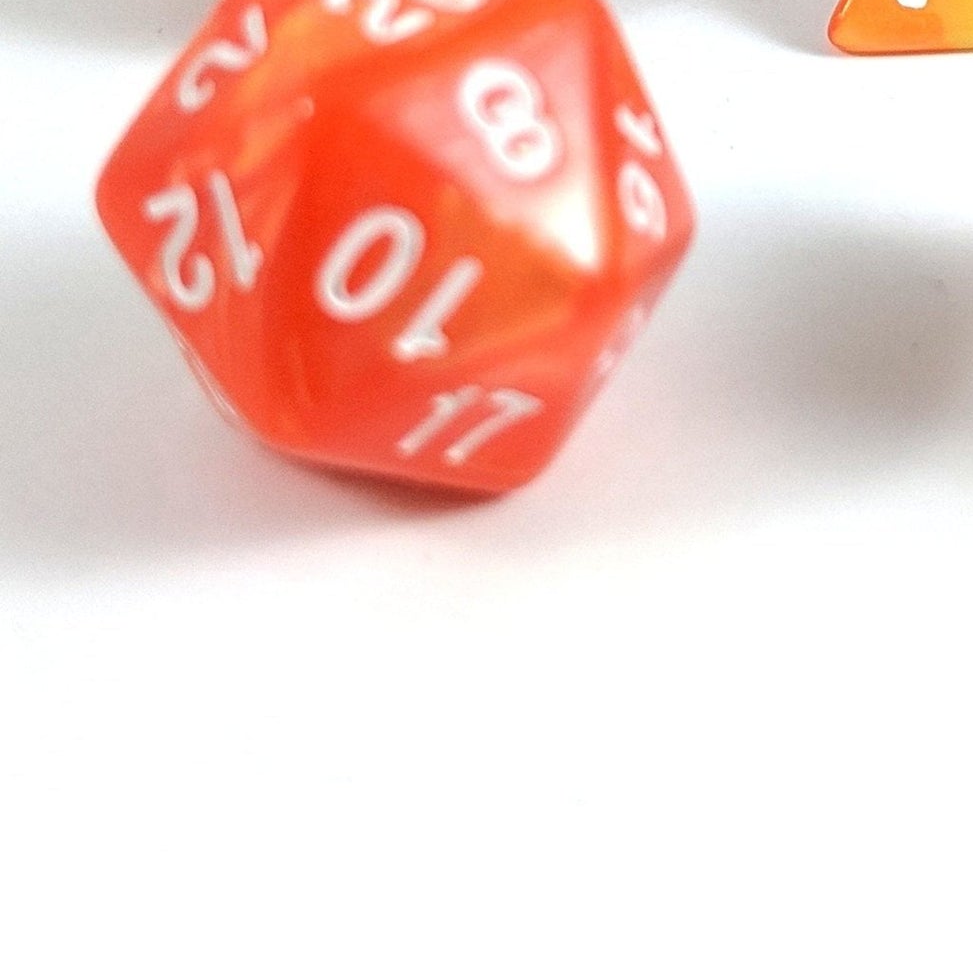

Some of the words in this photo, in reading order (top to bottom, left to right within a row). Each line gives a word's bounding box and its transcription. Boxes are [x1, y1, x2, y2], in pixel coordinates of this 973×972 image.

[176, 4, 269, 114] 2
[457, 58, 561, 182] 8
[144, 169, 264, 311] 12
[314, 205, 483, 363] 10
[396, 385, 543, 465] 17
